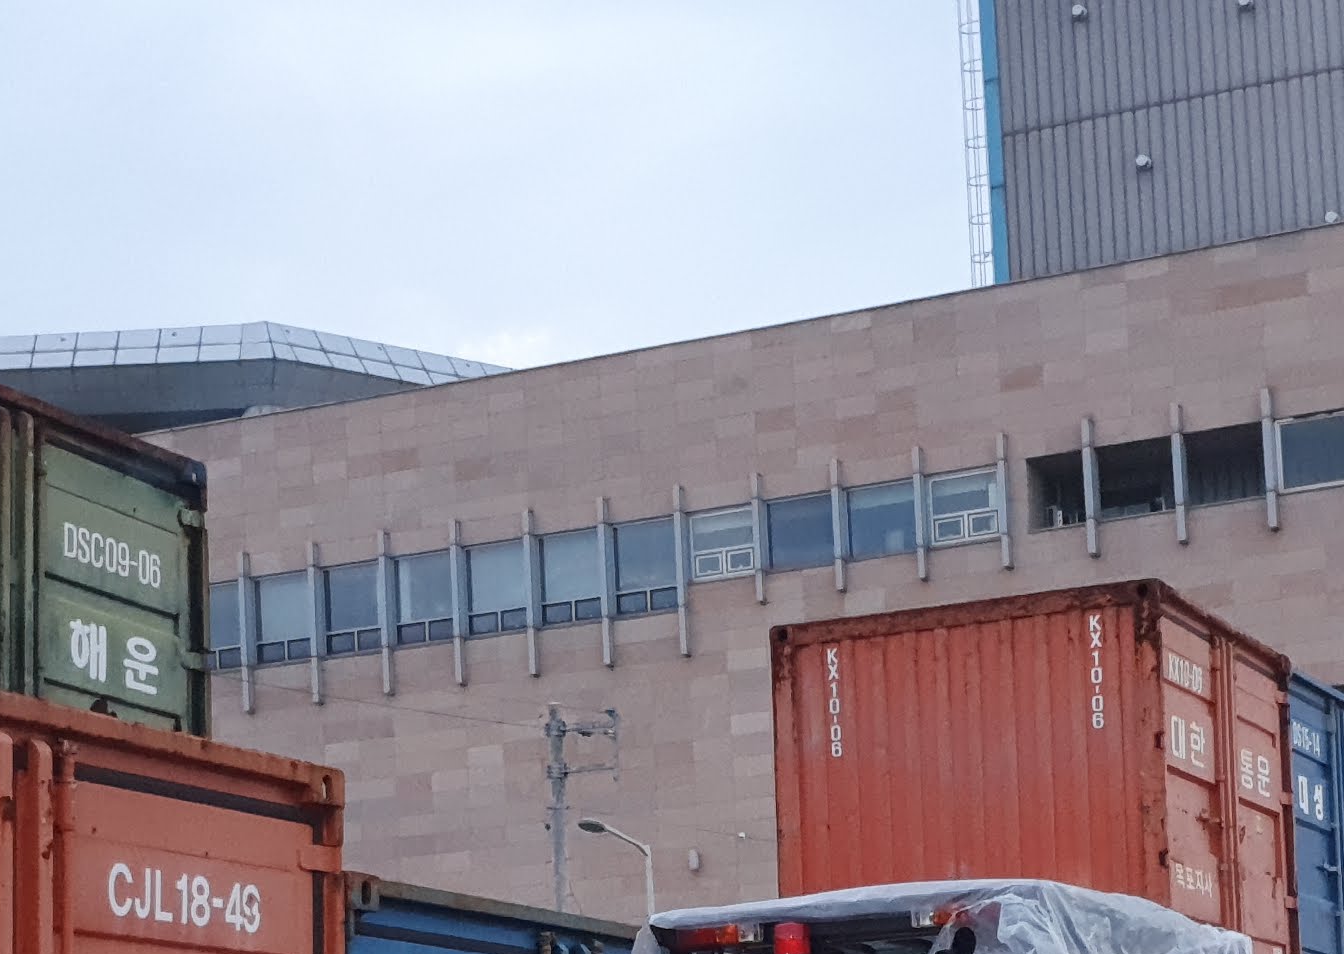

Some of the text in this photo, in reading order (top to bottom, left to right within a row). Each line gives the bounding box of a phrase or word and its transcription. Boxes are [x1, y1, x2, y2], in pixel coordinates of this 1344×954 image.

[63, 521, 161, 589] DSC09-06
[826, 647, 843, 758] KX10-06
[1089, 614, 1105, 729] KX10-06
[1170, 715, 1206, 768] 대한
